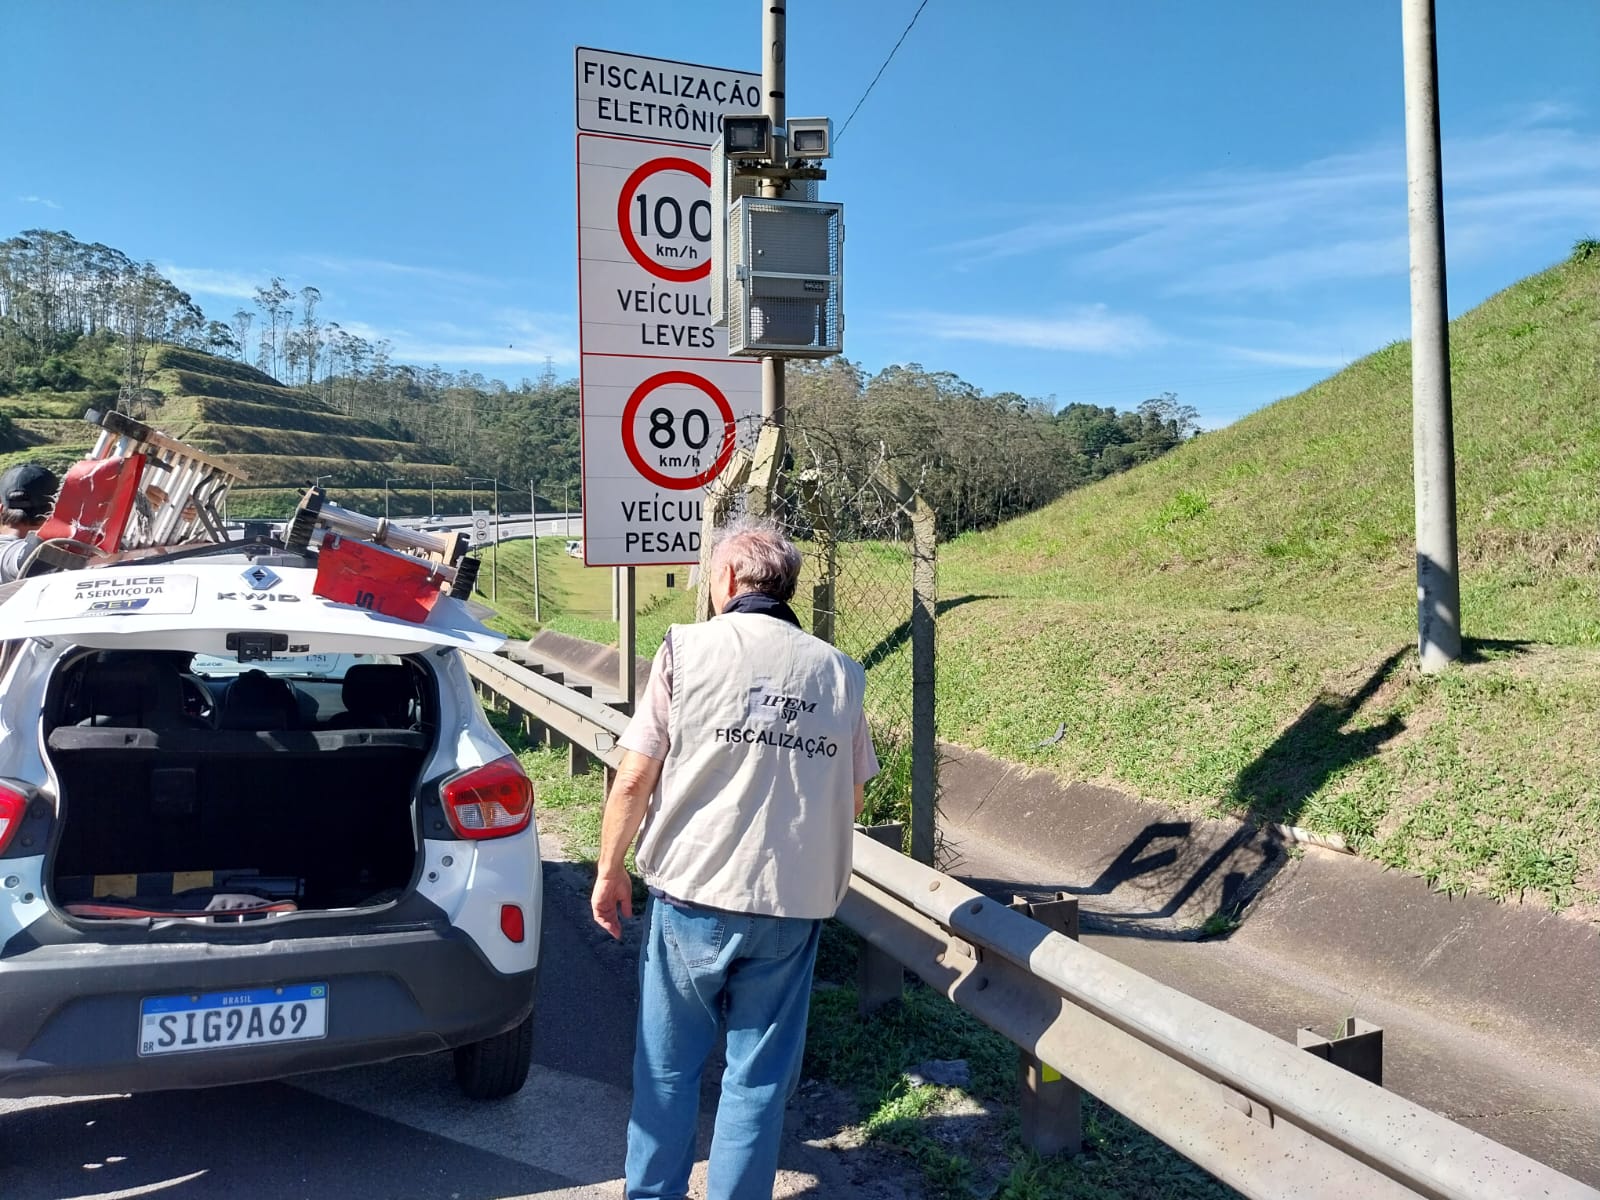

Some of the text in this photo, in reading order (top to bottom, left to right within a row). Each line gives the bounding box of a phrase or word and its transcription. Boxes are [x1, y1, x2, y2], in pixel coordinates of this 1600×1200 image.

[597, 97, 724, 134] ELETRÔNI
[636, 193, 712, 243] 100
[655, 243, 698, 260] km/h
[616, 282, 712, 316] VEÍCUL
[641, 323, 716, 348] LEVES
[648, 407, 710, 450] 80
[659, 454, 701, 467] km/h
[621, 493, 703, 522] VEÍCUL
[625, 531, 702, 553] PESAD
[74, 586, 164, 600] A SERVIÇO DA
[75, 576, 165, 590] SPLICE
[90, 599, 138, 610] CET
[217, 591, 301, 603] KWID
[761, 694, 818, 714] IPEM
[714, 728, 838, 758] FISCALIZAÇÃO
[222, 995, 252, 1006] BRASIL
[157, 1002, 307, 1048] SIG9A69
[143, 1041, 154, 1052] BR
